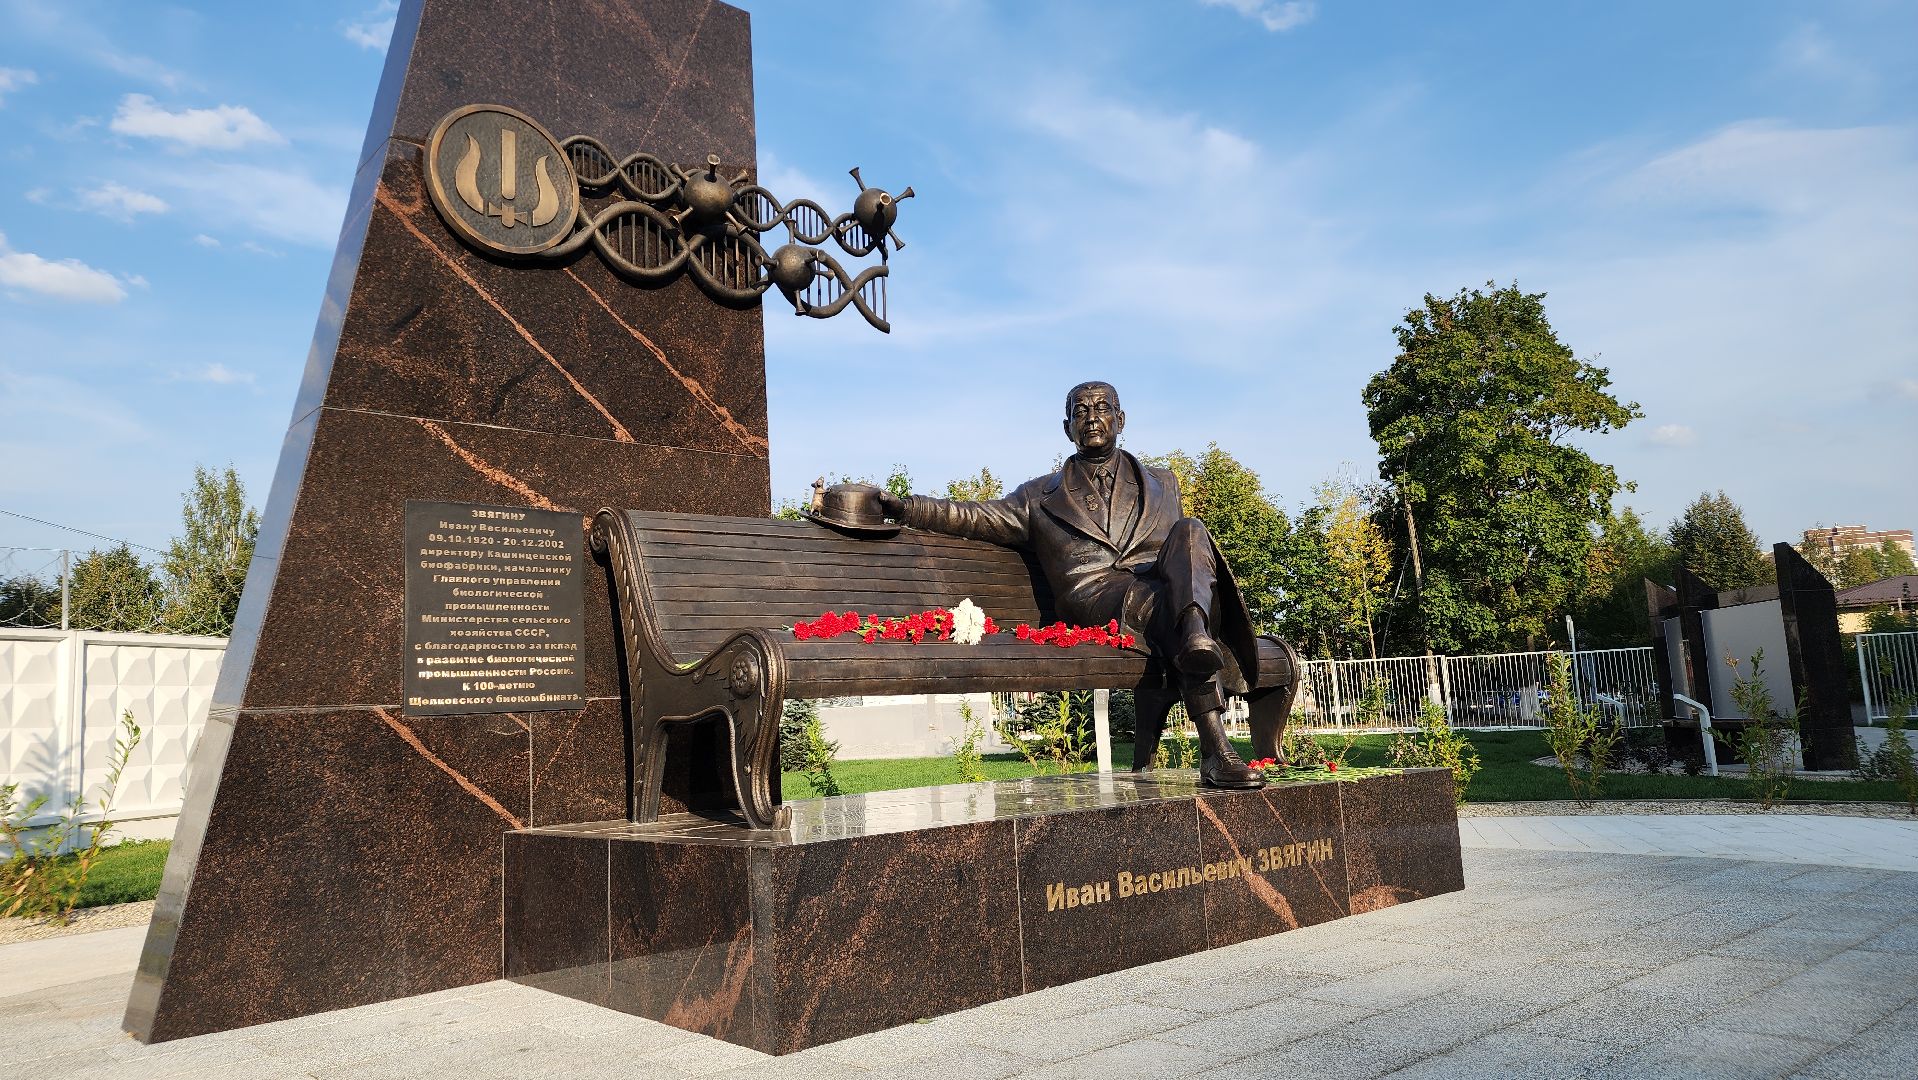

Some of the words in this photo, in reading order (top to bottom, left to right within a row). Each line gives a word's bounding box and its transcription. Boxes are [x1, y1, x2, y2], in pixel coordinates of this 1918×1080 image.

[472, 510, 525, 521] ЗВЯГИНУ
[440, 521, 477, 531] Ивану
[479, 524, 555, 536] Васильевичу
[429, 534, 494, 544] 09.10.1920
[503, 538, 564, 548] 20.12.2002
[488, 551, 572, 561] Кашинцевской
[420, 561, 501, 572] биофабрики,
[504, 565, 572, 575] начальнику
[433, 575, 490, 584] Главного
[492, 578, 560, 586] управления
[453, 586, 543, 598] биологической
[445, 603, 549, 612] промышленности
[422, 615, 508, 623] Министерства
[450, 628, 512, 637] хозяйства
[515, 629, 549, 637] СССР,
[425, 642, 525, 651] благодарностью
[427, 656, 484, 665] развитие
[487, 655, 575, 663] биологической
[418, 668, 527, 679] промышленности
[474, 682, 535, 690] 100-летию
[496, 693, 582, 703] биокомбината.
[1046, 880, 1110, 912] Иван
[1118, 857, 1252, 898] Васильевич
[1258, 838, 1333, 872] ЗВЯГИН
